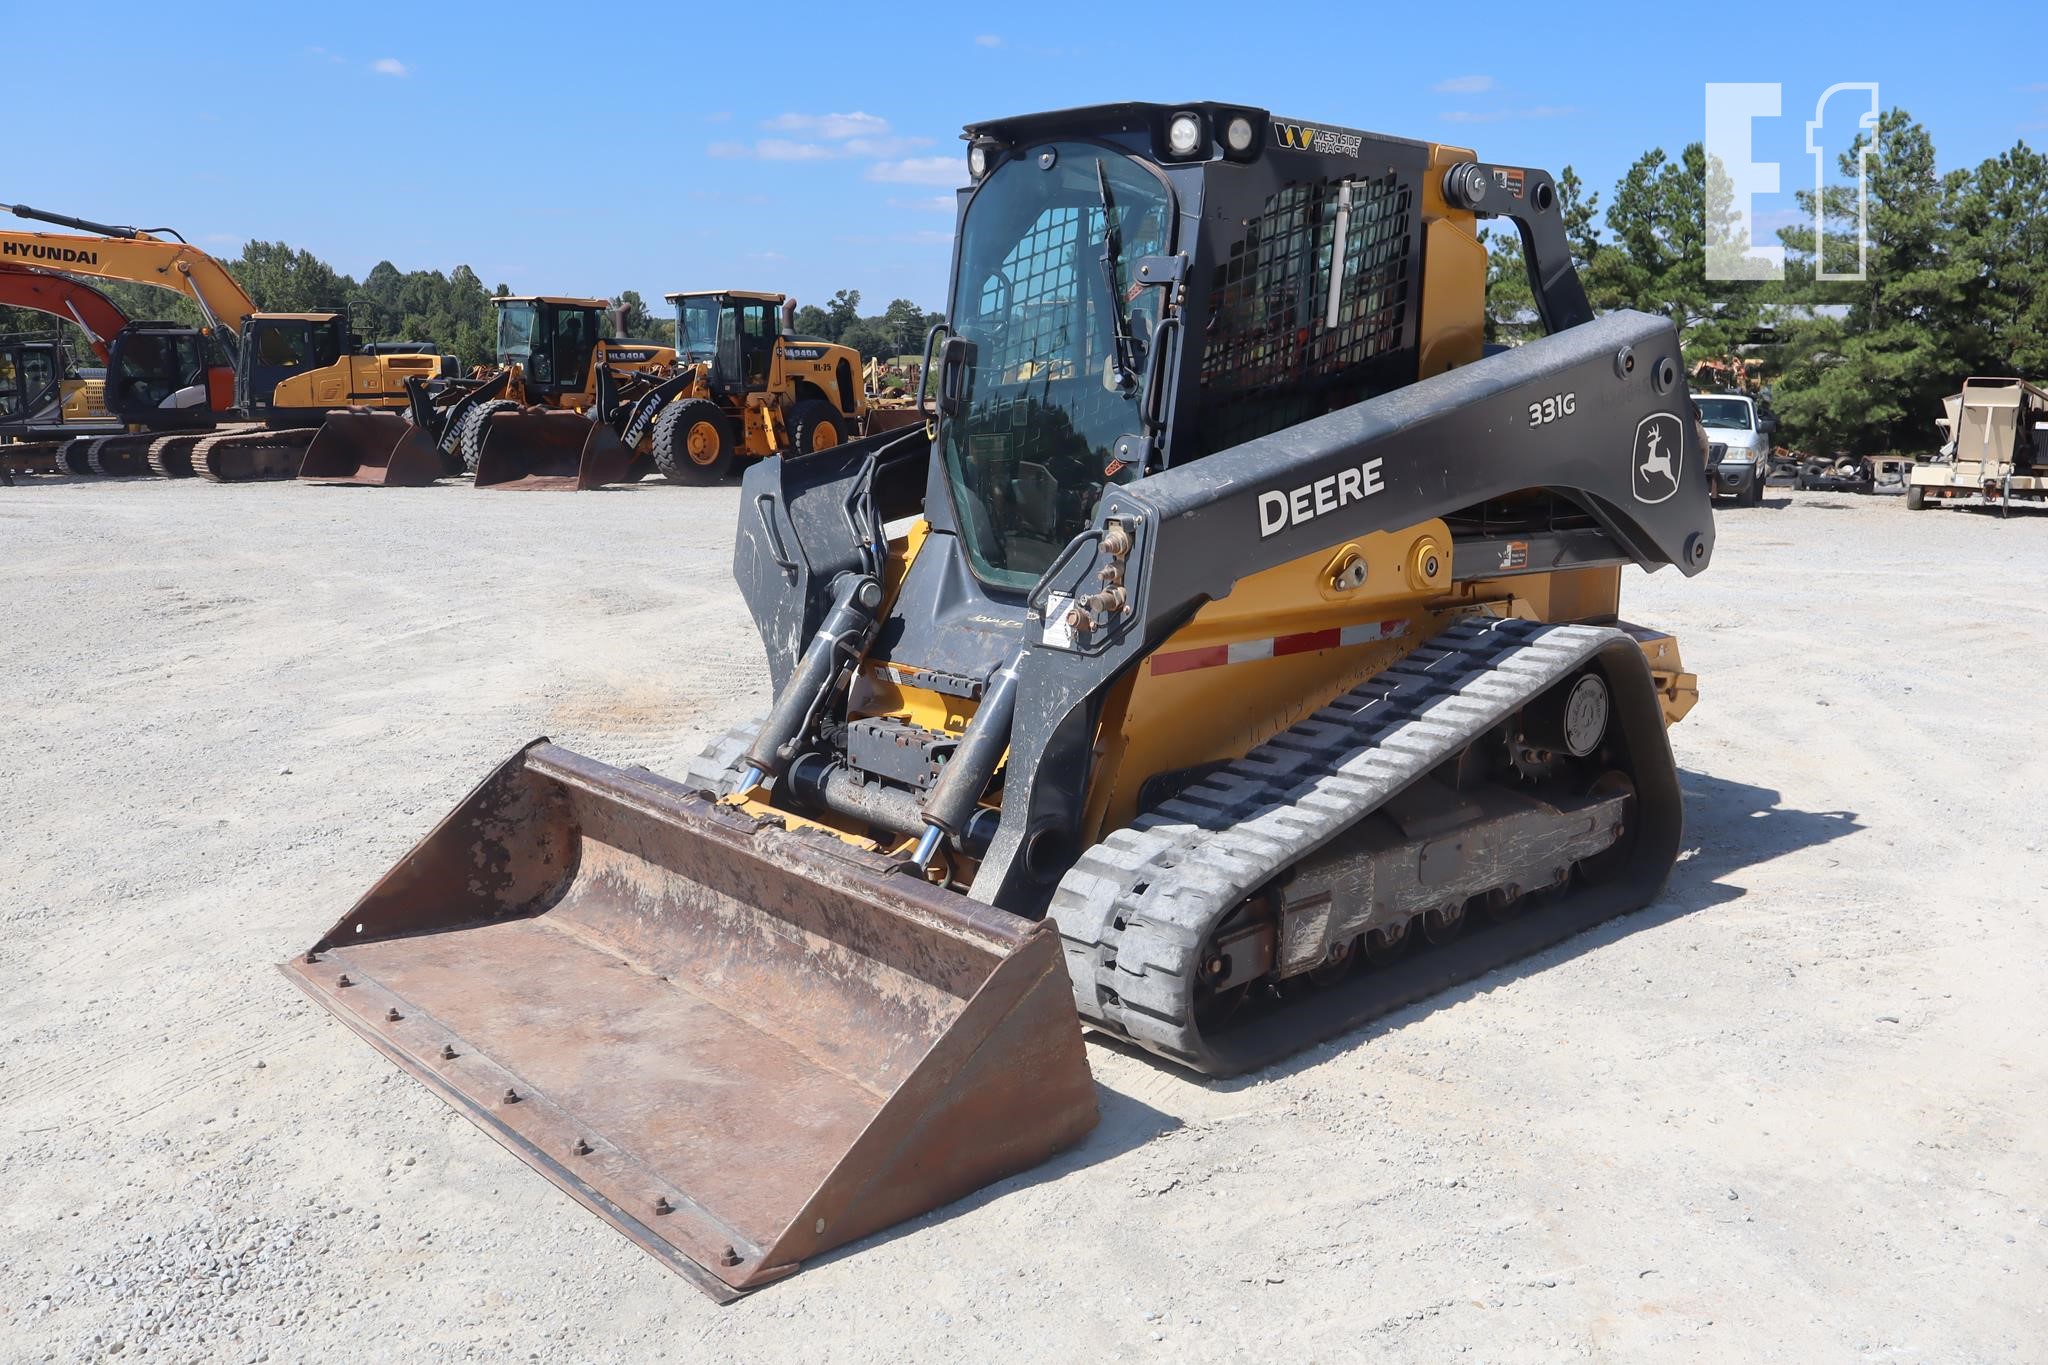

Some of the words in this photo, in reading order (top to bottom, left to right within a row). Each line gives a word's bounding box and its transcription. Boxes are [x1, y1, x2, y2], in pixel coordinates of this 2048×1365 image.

[1314, 141, 1359, 158] TRACTOR
[1315, 129, 1340, 143] WEST
[1341, 133, 1362, 147] SIDE
[3, 241, 98, 265] HYUNDAI
[625, 392, 662, 446] HYUNDAI
[1528, 392, 1576, 427] 331G
[1258, 457, 1385, 537] DEERE
